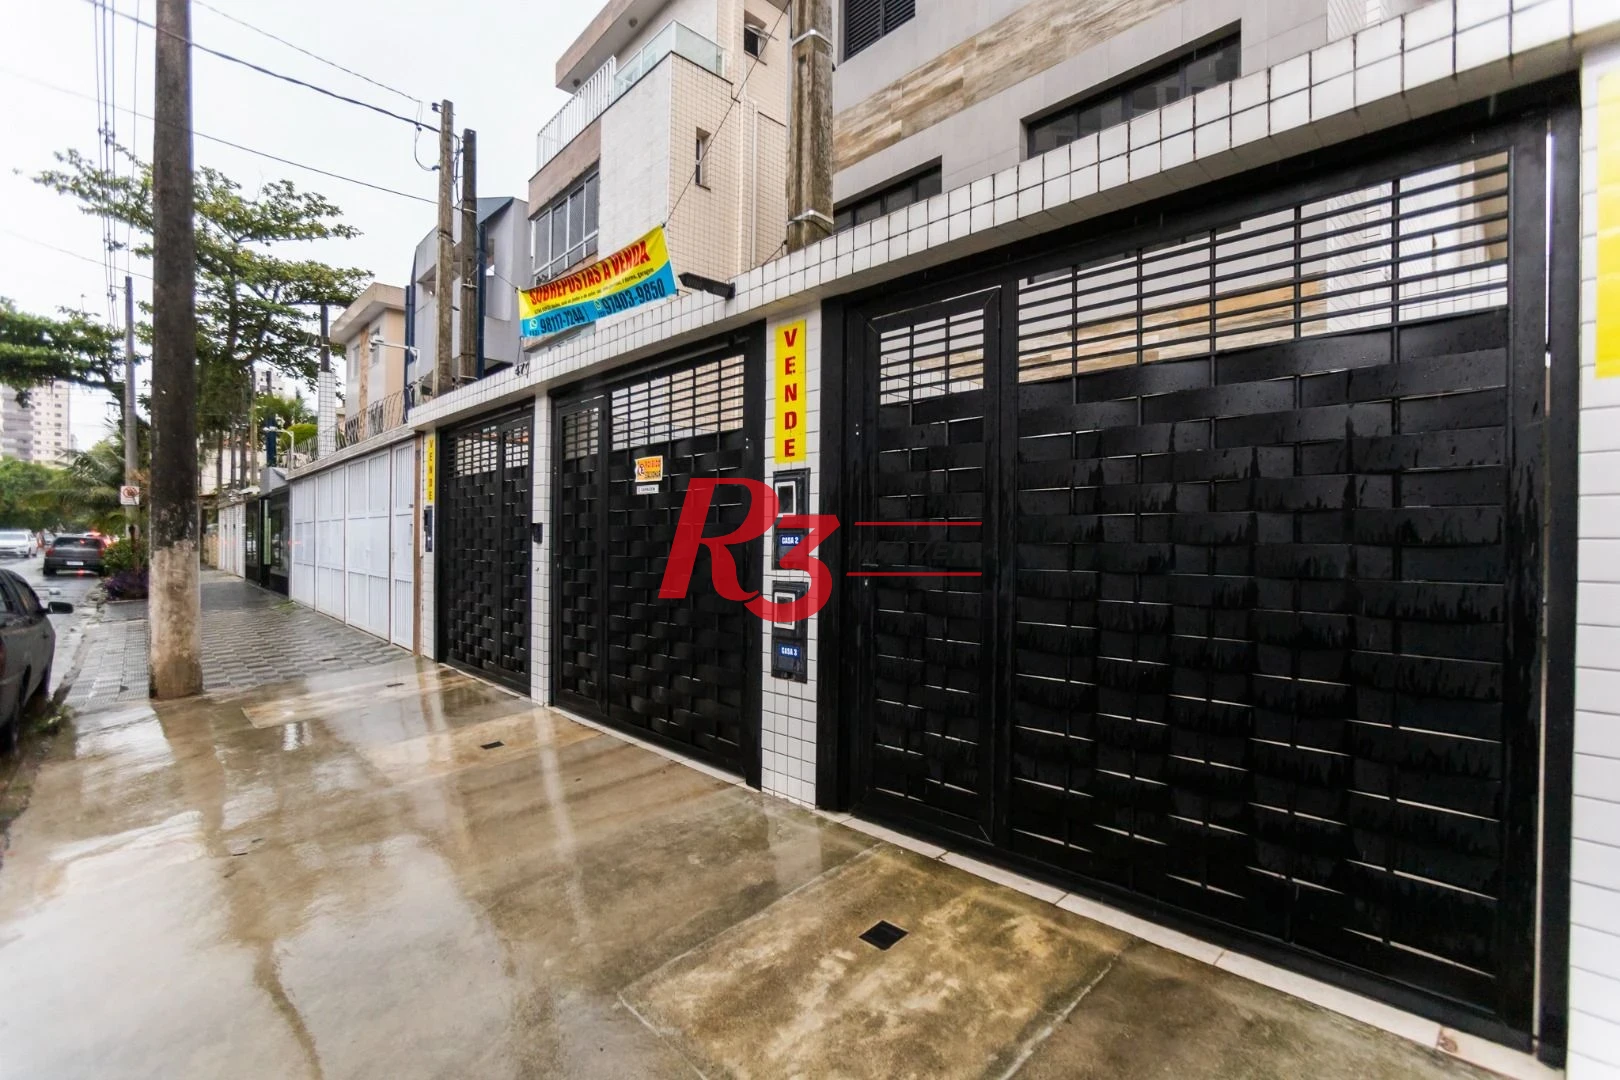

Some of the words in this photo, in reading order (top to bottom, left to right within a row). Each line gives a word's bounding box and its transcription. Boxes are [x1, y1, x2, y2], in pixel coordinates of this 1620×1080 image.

[529, 266, 601, 305] SOBREPOSTAS
[611, 240, 651, 276] VENDA
[601, 278, 665, 316] 97403-9850
[540, 307, 585, 333] 98117-7244
[784, 328, 798, 458] VENDE
[781, 536, 794, 544] CASA
[794, 536, 799, 544] 2
[781, 647, 793, 655] CASA
[793, 648, 798, 656] 3
